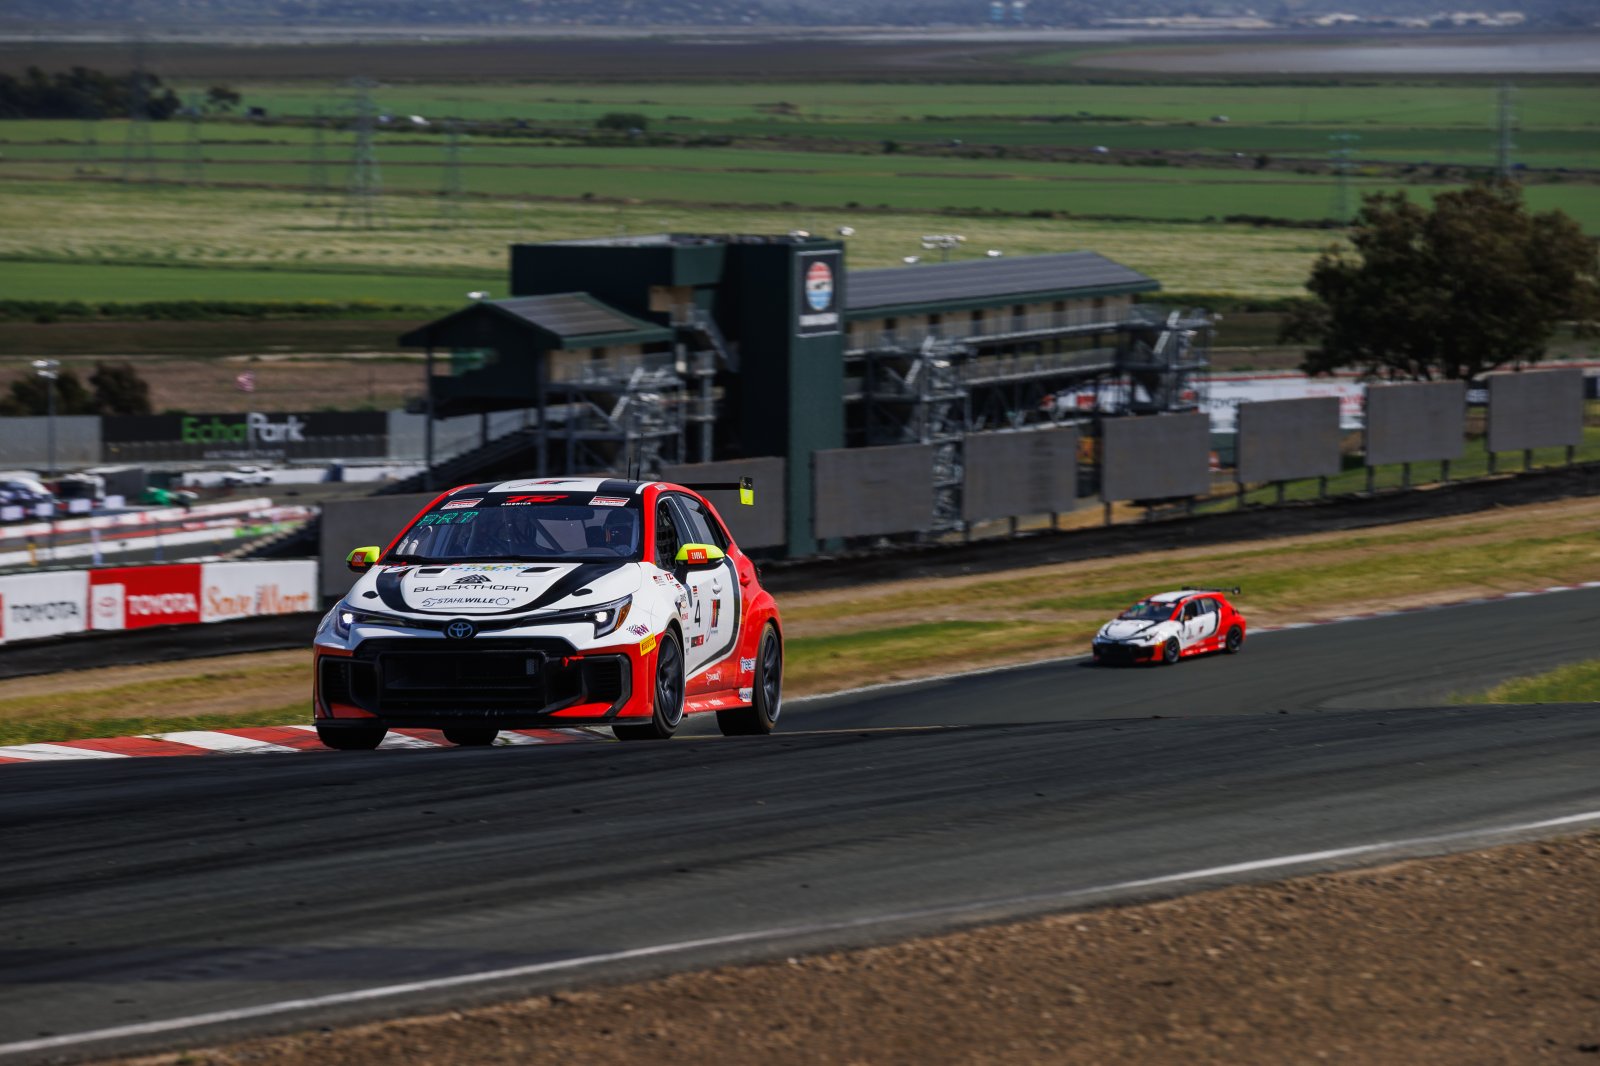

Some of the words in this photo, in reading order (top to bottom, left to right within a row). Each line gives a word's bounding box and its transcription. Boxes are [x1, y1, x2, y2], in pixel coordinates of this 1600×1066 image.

[181, 412, 305, 444] EchoPark
[206, 586, 252, 617] Save
[254, 583, 309, 615] Mart
[413, 584, 529, 592] BLACKTHORN
[10, 600, 80, 622] TOYOTA
[127, 593, 198, 616] TOYOTA
[694, 599, 701, 628] 4
